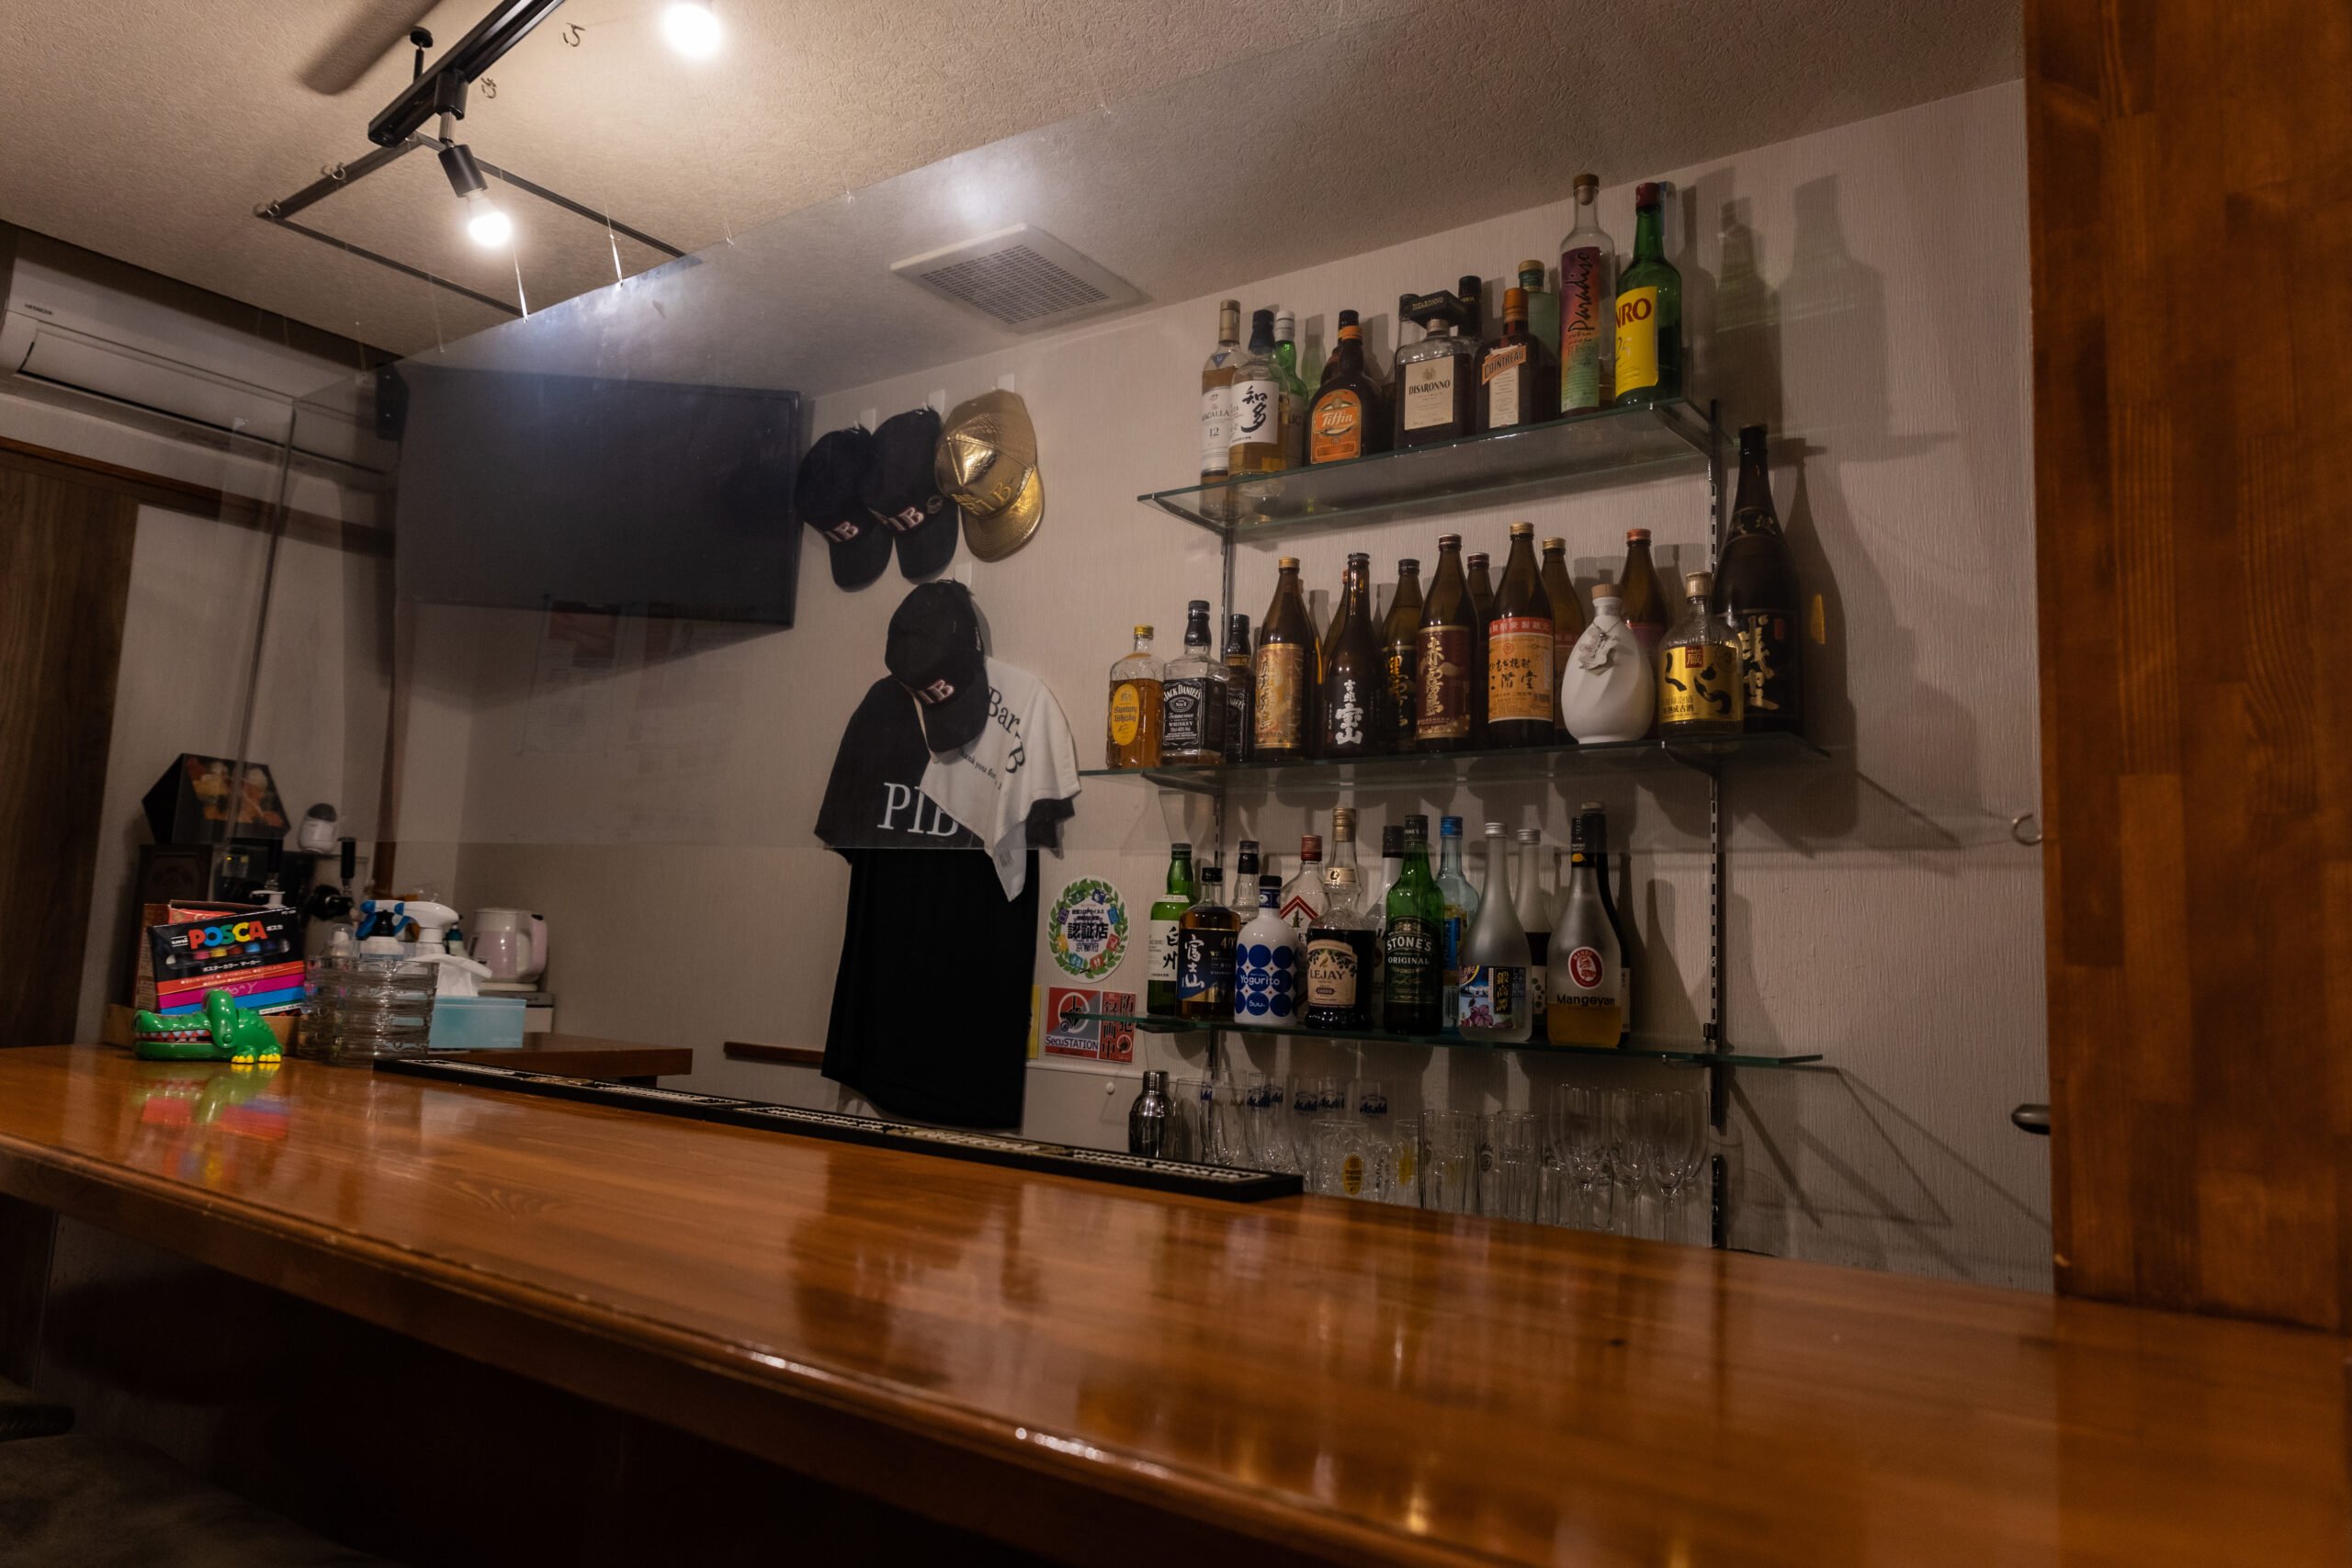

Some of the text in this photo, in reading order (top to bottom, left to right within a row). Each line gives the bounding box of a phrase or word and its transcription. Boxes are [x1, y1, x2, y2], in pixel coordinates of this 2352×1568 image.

[1616, 299, 1652, 328] NRO
[1484, 349, 1525, 379] COINTREAU
[1408, 379, 1451, 396] DISARONNO
[1241, 385, 1268, 434] 知多
[1322, 410, 1353, 428] Tiffin
[1209, 426, 1219, 438] 12
[824, 520, 860, 544] IB
[916, 678, 956, 705] IB
[1163, 683, 1202, 703] JACK DANIEL'S
[187, 919, 268, 950] POSCA
[1067, 922, 1109, 940] 認証店
[1075, 942, 1100, 953] 京都府
[1386, 935, 1432, 953] STONE'S
[1387, 955, 1430, 966] ORIGINAL
[1240, 975, 1280, 986] Yogurito
[1310, 970, 1345, 980] LEJAY
[1046, 1035, 1099, 1051] SecuSTATION
